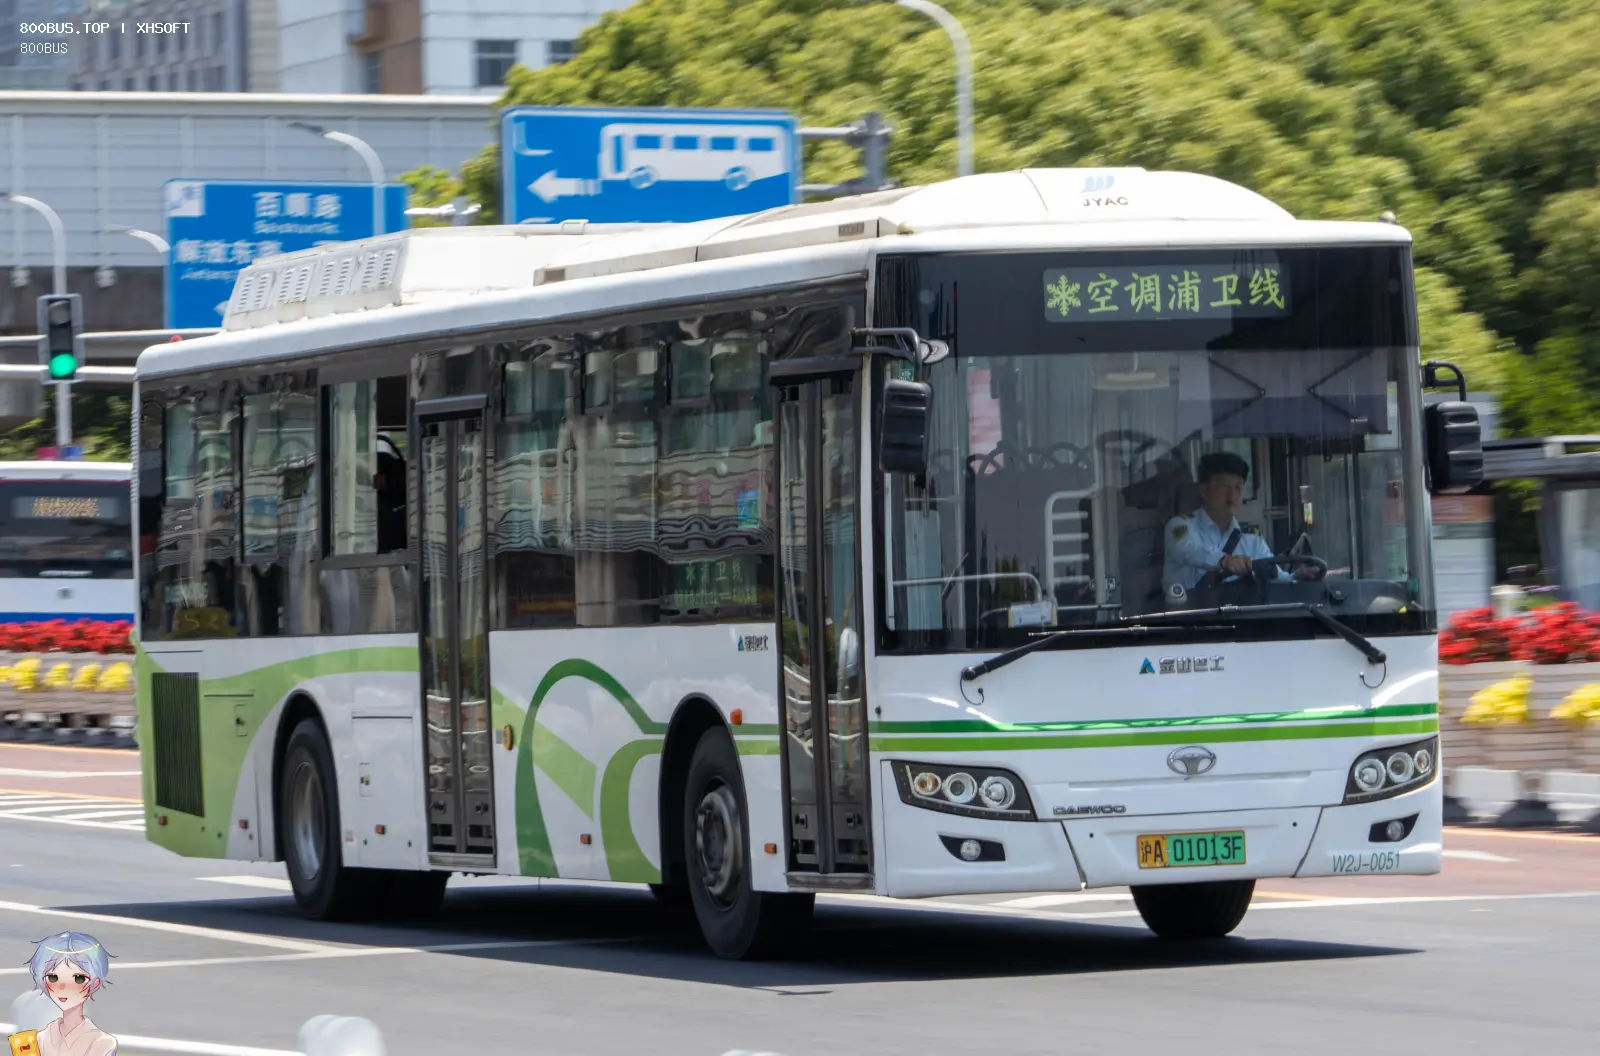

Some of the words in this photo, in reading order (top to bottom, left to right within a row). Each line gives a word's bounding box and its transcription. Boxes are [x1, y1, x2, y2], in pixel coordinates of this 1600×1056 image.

[1082, 196, 1129, 207] JYAC
[1087, 267, 1285, 313] 空调浦卫线
[1053, 804, 1126, 816] DAEWOO
[1173, 836, 1242, 862] 01013F
[1333, 850, 1400, 873] W2J-0051
